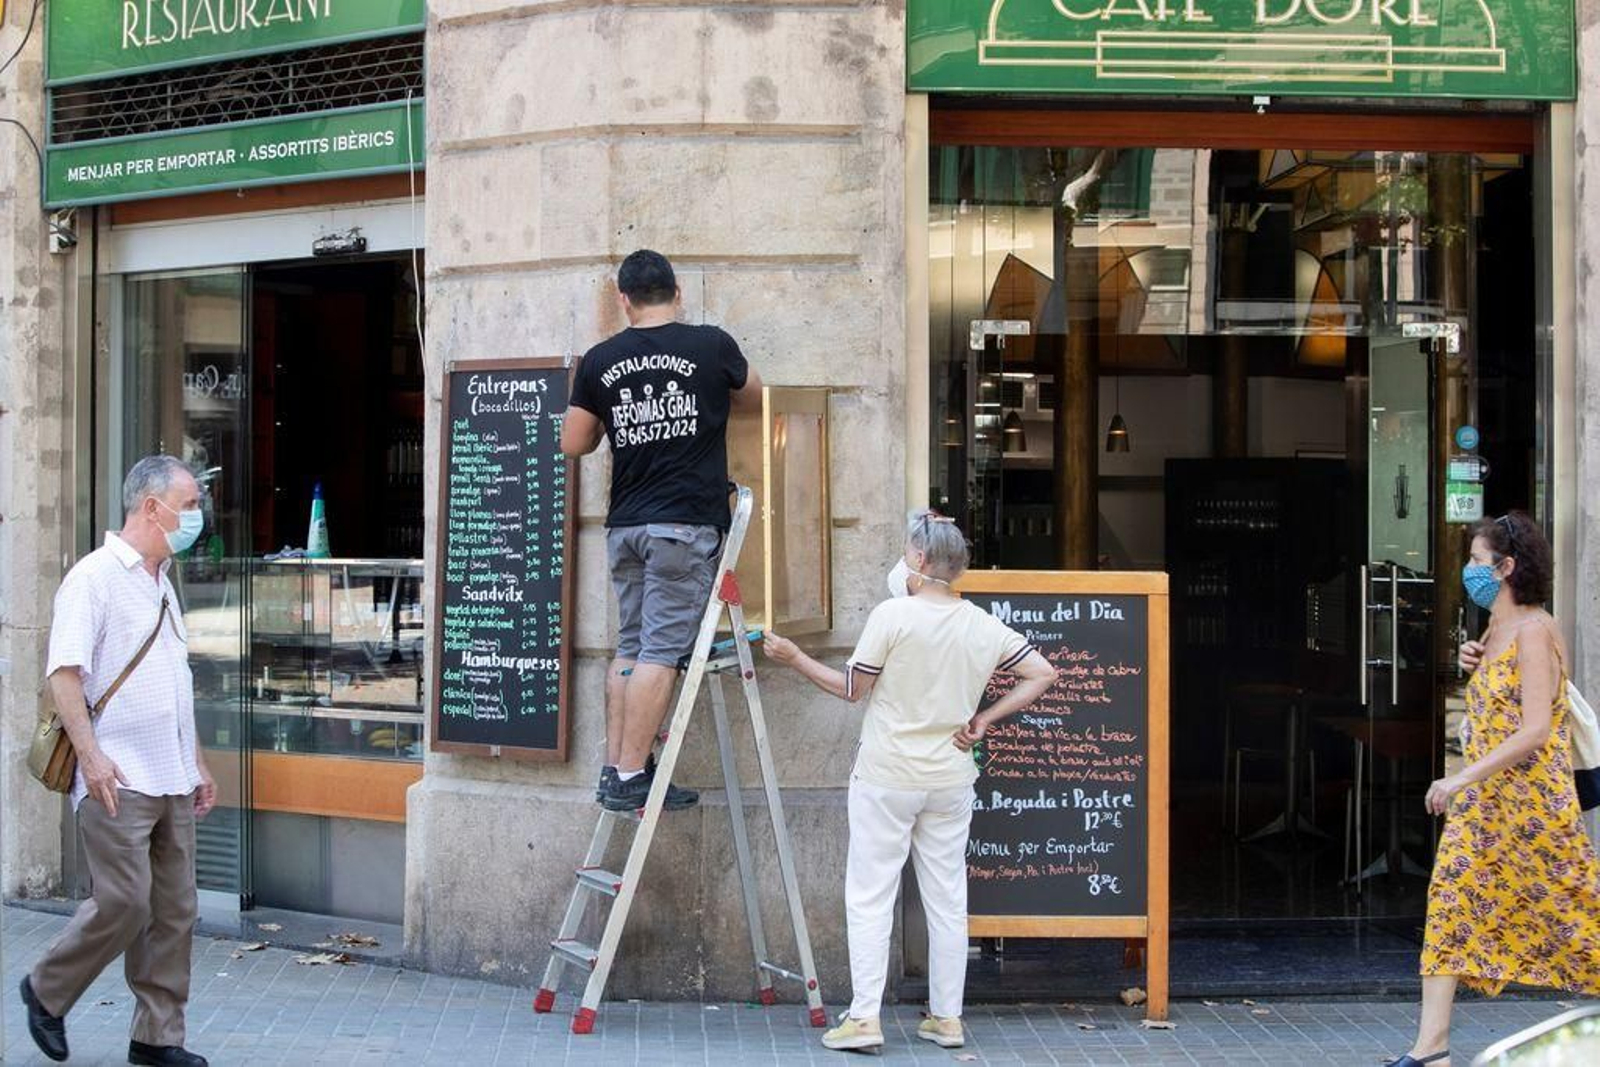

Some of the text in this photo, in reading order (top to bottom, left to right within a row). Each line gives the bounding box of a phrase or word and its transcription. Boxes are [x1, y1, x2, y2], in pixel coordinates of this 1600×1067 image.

[67, 130, 395, 182] MENJAR PER EMPORTAR ASSORTITS IBÈRICS
[600, 354, 697, 388] INSTALACIONES
[467, 375, 548, 400] Entrepans
[667, 394, 698, 418] GRAL
[991, 600, 1046, 624] Menu
[1051, 601, 1081, 623] del
[461, 651, 560, 675] Hamburgueses
[991, 790, 1057, 816] Beguda
[1062, 792, 1068, 808] i
[1073, 788, 1135, 808] Postre
[967, 836, 1115, 864] Menu per Emportar
